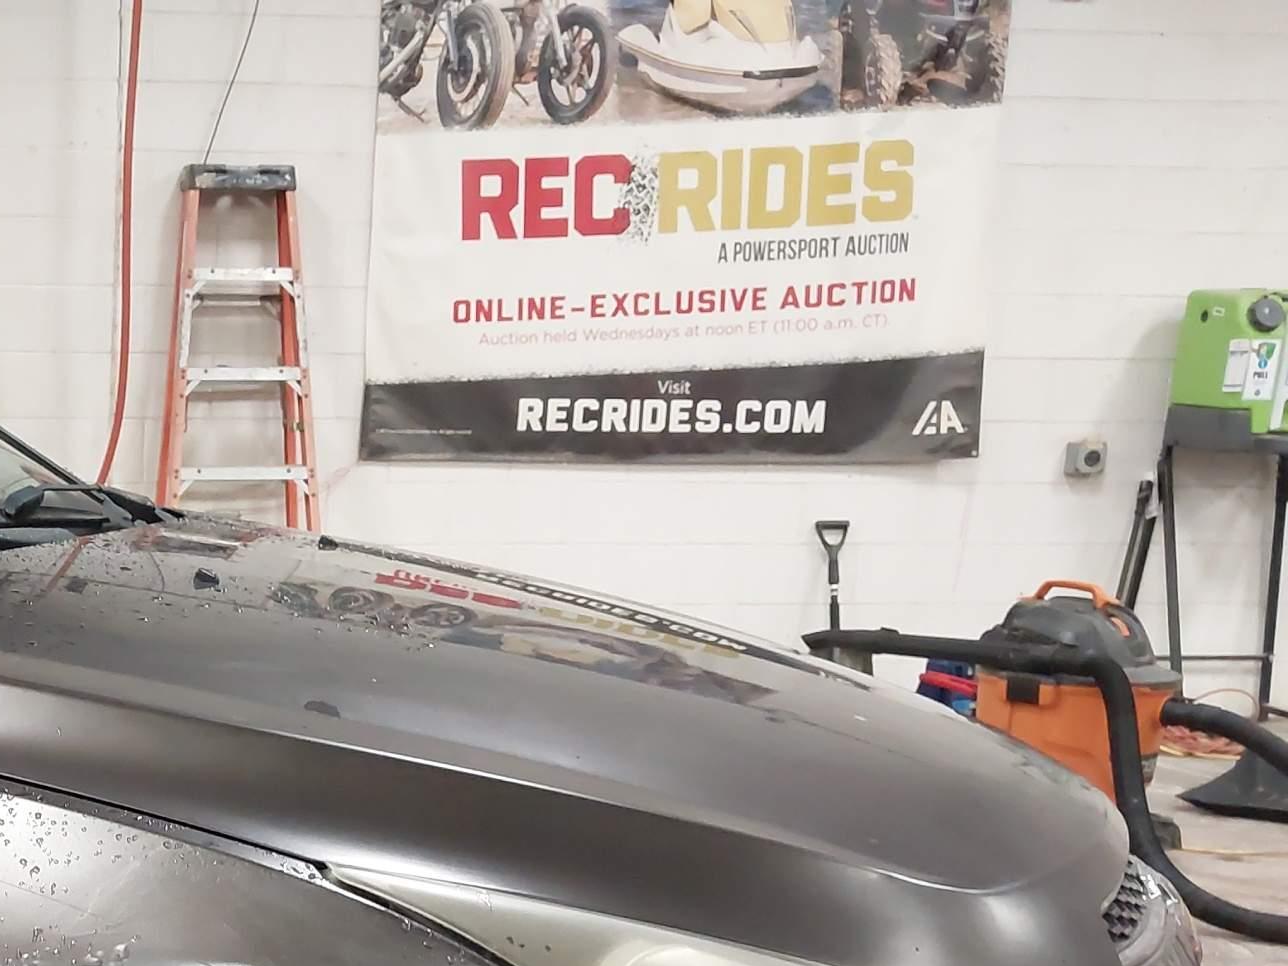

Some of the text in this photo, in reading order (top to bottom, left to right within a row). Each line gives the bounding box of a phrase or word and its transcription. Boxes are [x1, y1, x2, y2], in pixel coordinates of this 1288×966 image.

[461, 139, 914, 241] REC RIDES
[717, 232, 910, 264] A POWERSPORT AUCTION
[453, 277, 917, 323] ONLINE-EXCLUSIVE AUCTION
[479, 330, 539, 347] Auction
[543, 328, 578, 343] held
[582, 323, 681, 343] Wednesdays
[684, 324, 700, 338] at
[705, 322, 744, 337] noon
[748, 320, 768, 335] ET
[657, 379, 692, 395] Visit
[516, 398, 827, 434] RECRIDES.COM
